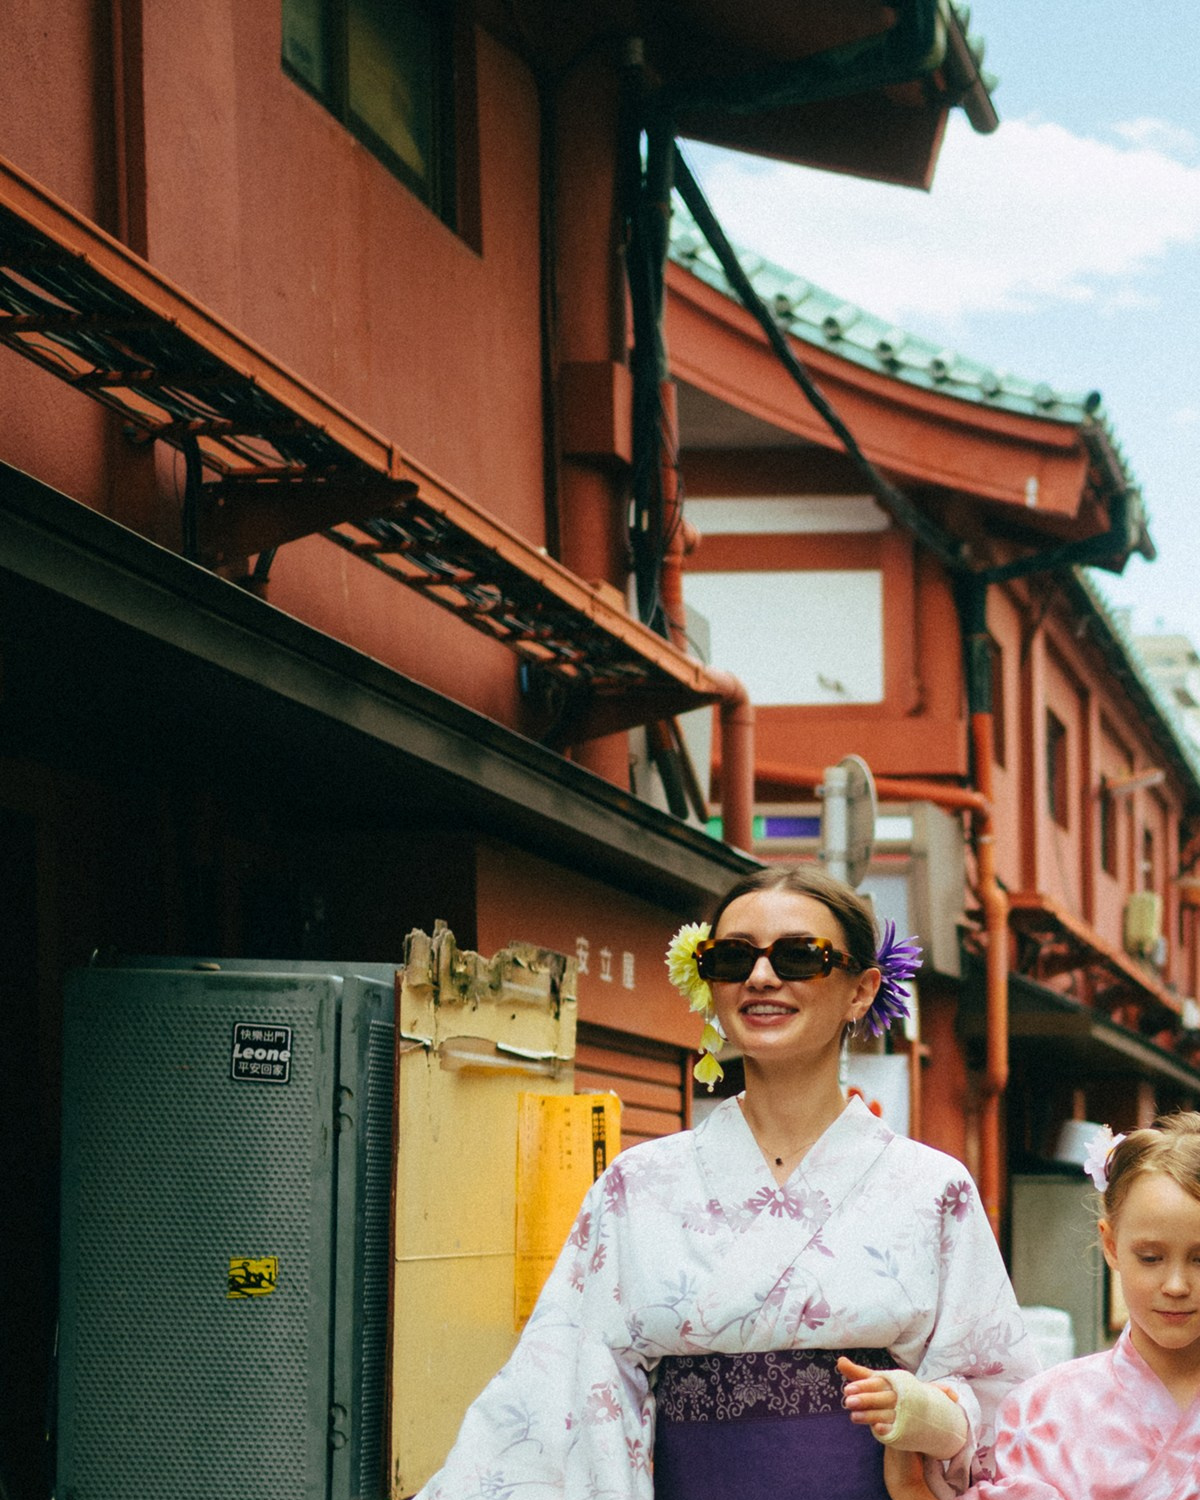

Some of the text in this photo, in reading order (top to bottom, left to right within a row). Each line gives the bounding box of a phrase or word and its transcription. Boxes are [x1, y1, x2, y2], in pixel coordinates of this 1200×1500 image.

[233, 1043, 291, 1062] Leone
[238, 1061, 284, 1076] 平安回家
